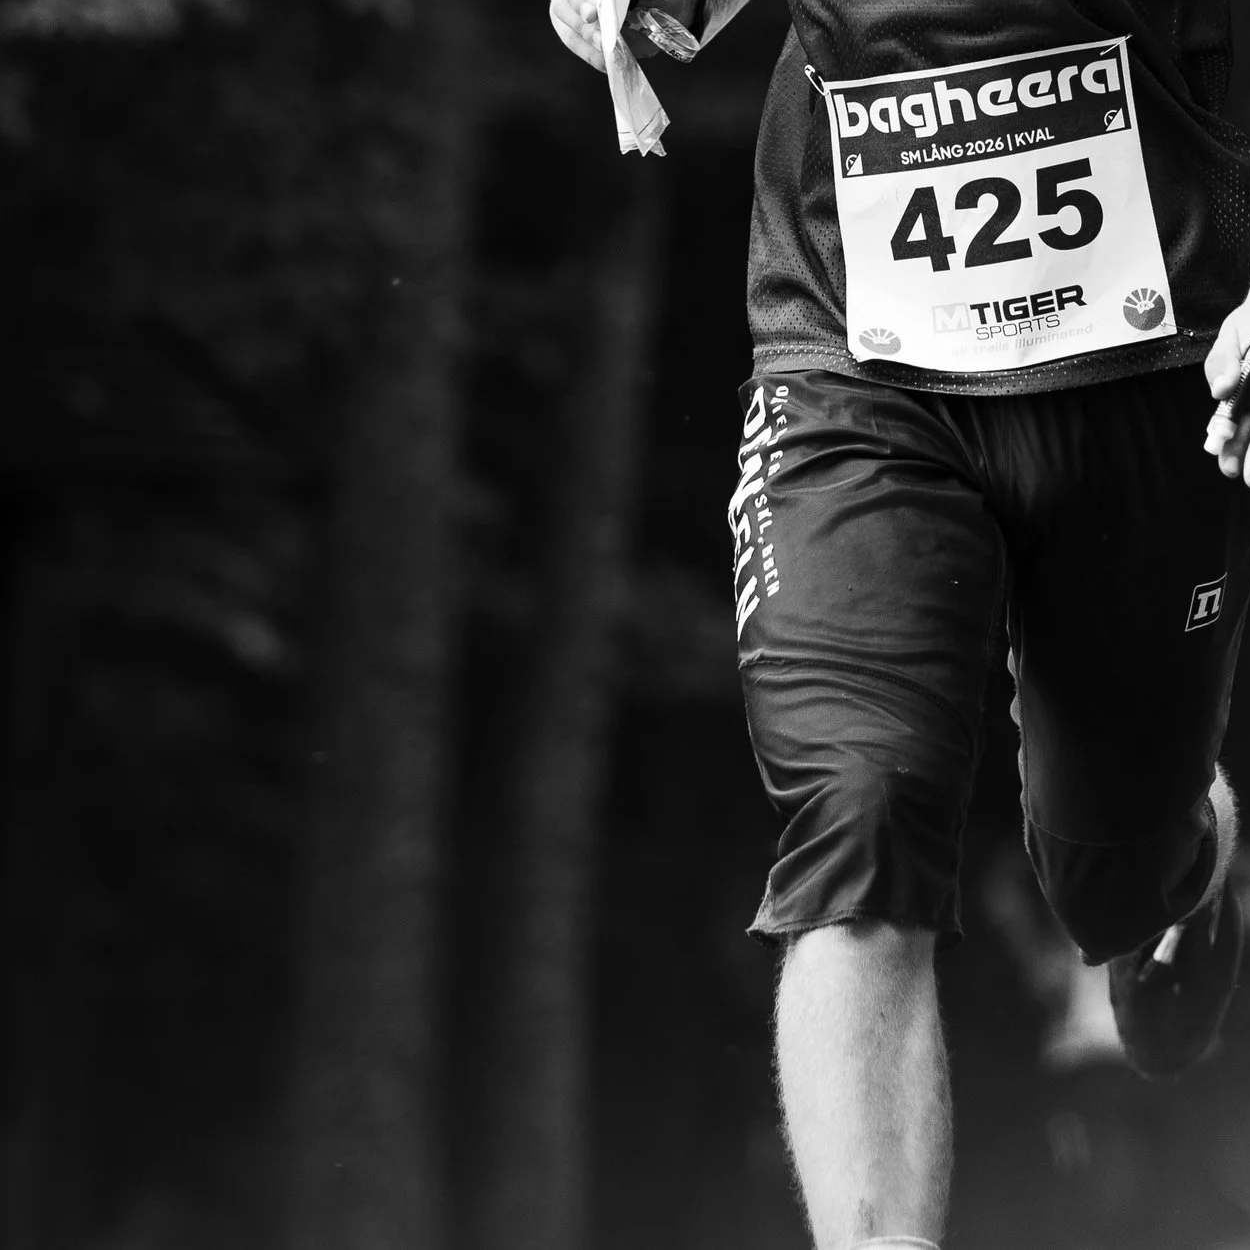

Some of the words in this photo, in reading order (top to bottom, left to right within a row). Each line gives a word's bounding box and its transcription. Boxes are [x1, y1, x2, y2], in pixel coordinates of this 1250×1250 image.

[833, 58, 1121, 139] bagheera
[901, 149, 922, 166] SM
[923, 143, 964, 163] LÅNG
[965, 137, 1005, 156] 2026
[1015, 127, 1055, 147] KVAL
[890, 157, 1104, 273] 425
[969, 284, 1088, 325] TIGER
[976, 314, 1061, 341] SPORTS
